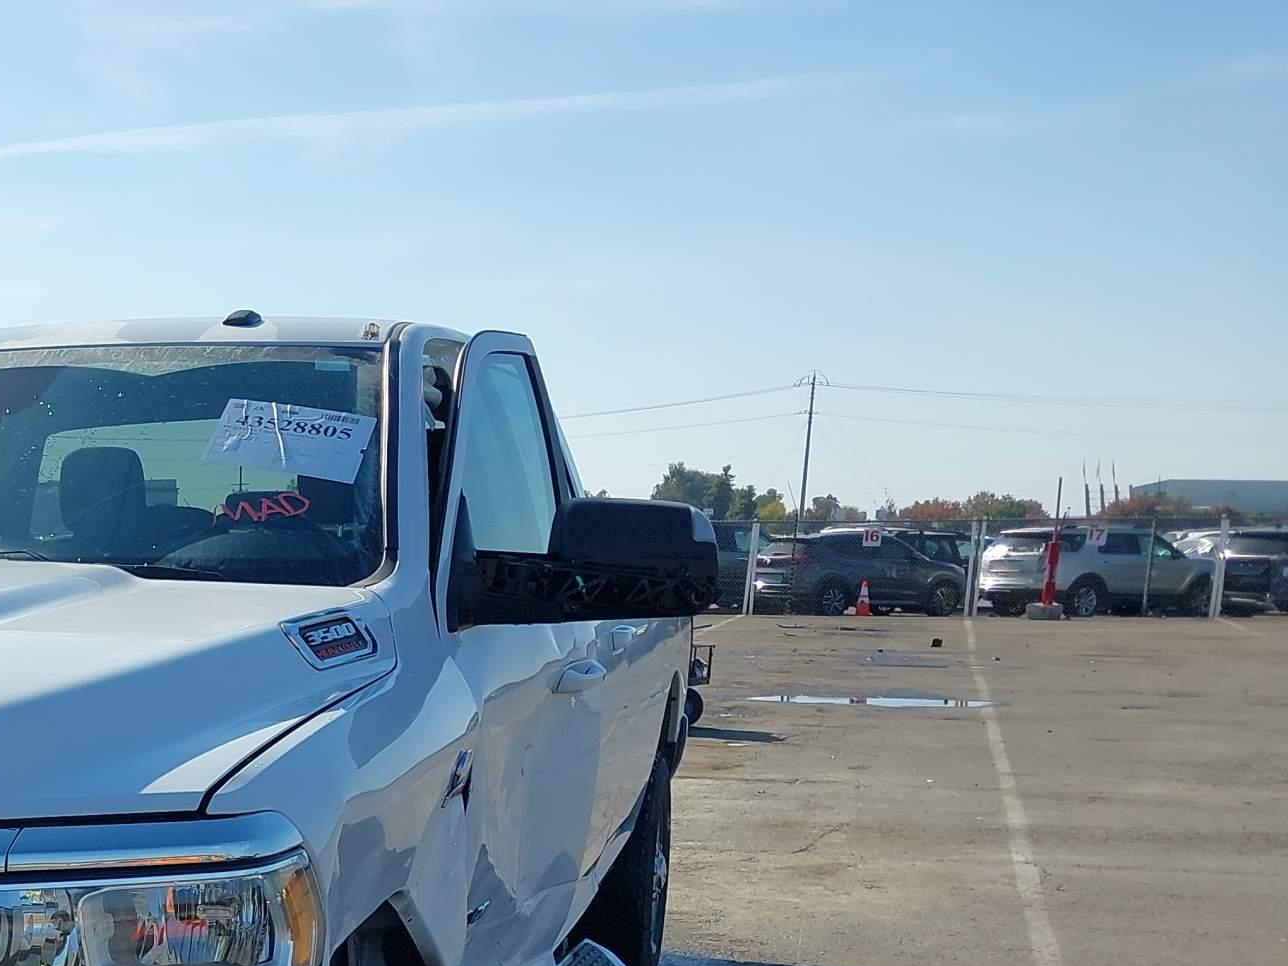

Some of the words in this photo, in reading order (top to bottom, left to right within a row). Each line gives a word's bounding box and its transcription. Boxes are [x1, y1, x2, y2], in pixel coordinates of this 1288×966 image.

[235, 415, 353, 440] 43528805
[863, 528, 880, 543] 16
[1088, 527, 1105, 541] 17
[303, 622, 357, 646] 3500
